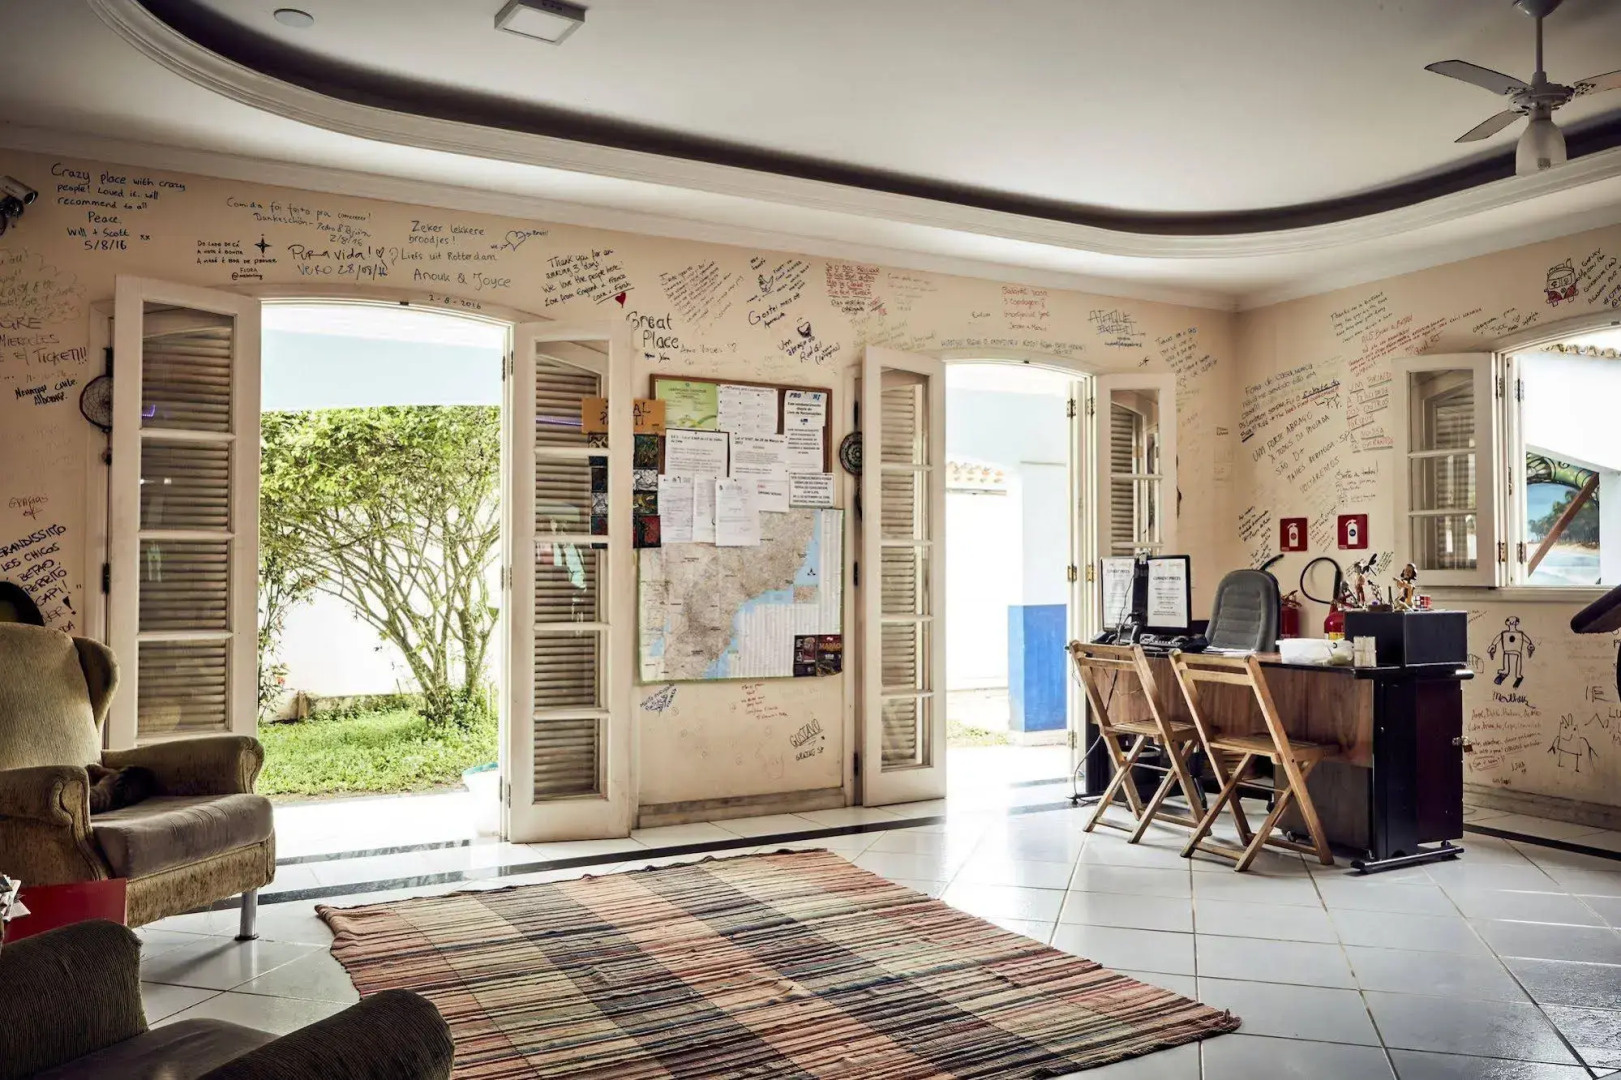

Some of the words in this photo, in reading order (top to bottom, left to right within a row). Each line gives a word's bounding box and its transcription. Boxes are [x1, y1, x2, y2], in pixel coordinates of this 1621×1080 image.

[51, 162, 91, 185] Crazy
[100, 171, 127, 185] place
[133, 176, 154, 187] with
[159, 180, 186, 192] crazy
[57, 184, 91, 194] people!
[98, 188, 124, 198] Loved
[57, 197, 117, 209] recommend
[124, 202, 133, 210] to
[136, 202, 148, 210] all
[226, 197, 263, 209] Comida
[270, 201, 282, 212] foi
[67, 227, 87, 237] Will
[103, 227, 130, 238] Scott
[411, 220, 442, 233] Zeker
[450, 224, 485, 236] lekkere
[84, 240, 127, 251] 5/8/16
[408, 235, 456, 246] broodjes!
[401, 248, 423, 261] Liefs
[429, 251, 441, 261] uit
[447, 250, 498, 261] Rotterdam
[547, 255, 573, 268] Thank
[575, 255, 589, 266] you
[572, 264, 580, 273] 3
[413, 269, 451, 282] Anouk
[457, 273, 467, 284] &
[473, 272, 511, 290] Joyce
[574, 275, 587, 284] the
[560, 293, 574, 304] from
[626, 311, 672, 331] Great
[643, 330, 679, 349] Place
[0, 558, 21, 572] LOS
[24, 543, 60, 562] CHICOS
